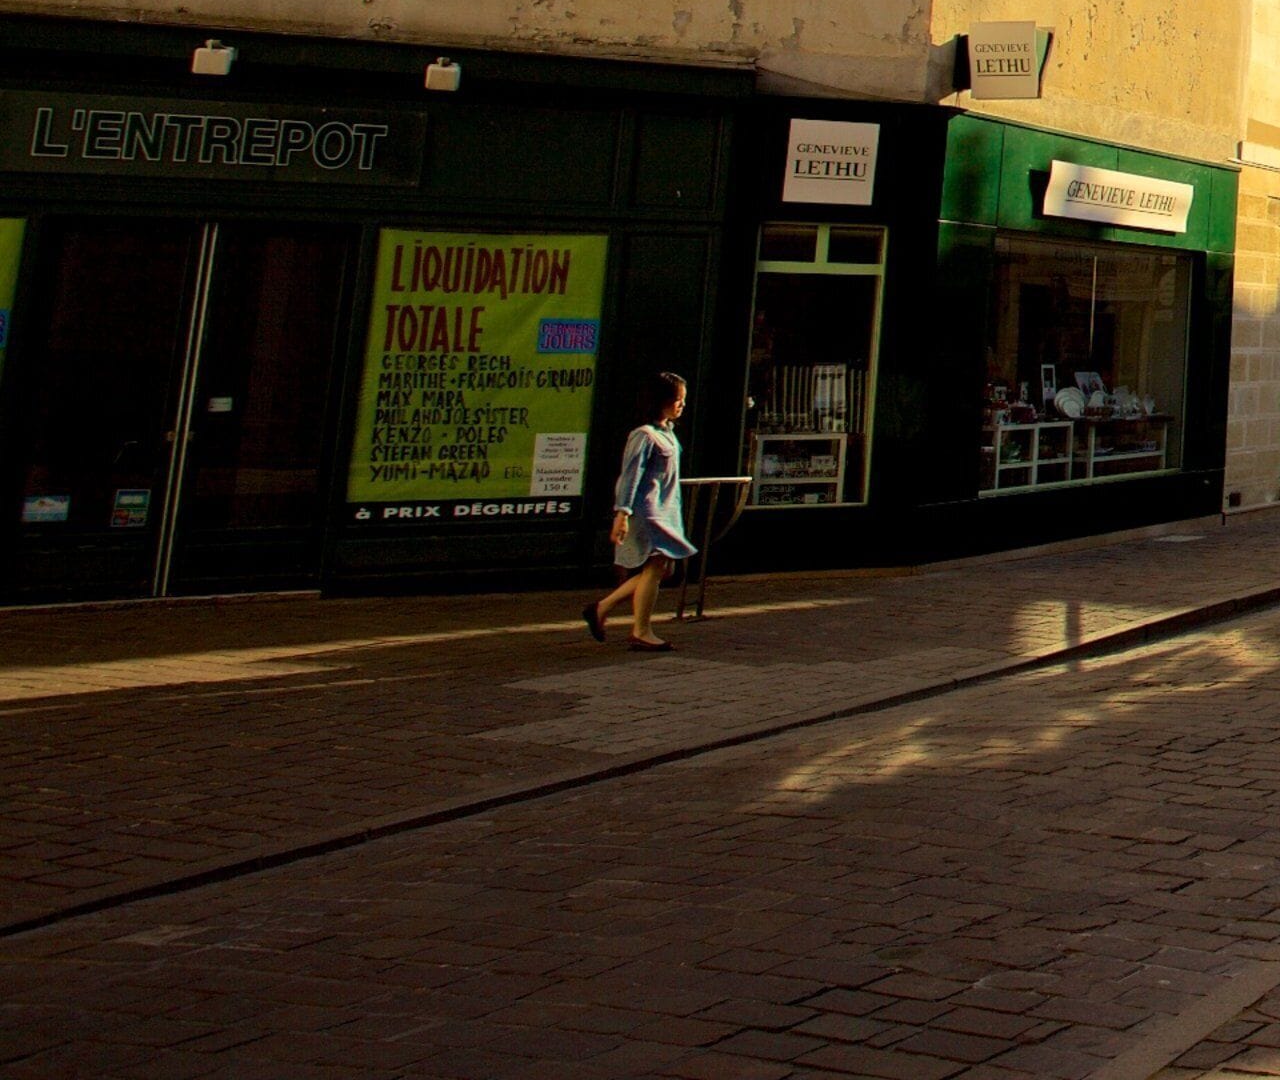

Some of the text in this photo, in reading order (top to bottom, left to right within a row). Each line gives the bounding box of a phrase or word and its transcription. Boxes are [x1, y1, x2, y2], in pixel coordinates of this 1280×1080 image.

[975, 43, 1030, 53] GENEVIEVE
[976, 58, 1030, 73] LETHU
[31, 107, 388, 170] L'ENTREPOT
[796, 143, 870, 156] GENEVIEVE
[794, 159, 867, 177] LETHU
[1067, 180, 1176, 212] GENEVIEVE LETHU
[390, 239, 571, 300] LIQUIDATION
[384, 304, 485, 353] TOTALE
[541, 323, 596, 335] DERNIERS
[540, 333, 595, 350] JOURS
[382, 354, 511, 371] GEORGES RECH
[376, 390, 467, 410] MAX MARA
[371, 426, 432, 445] KENZO
[456, 426, 508, 444] POLES
[438, 444, 488, 462] GREEN
[354, 500, 572, 520] à PRIX DÉGRIFFÉS
